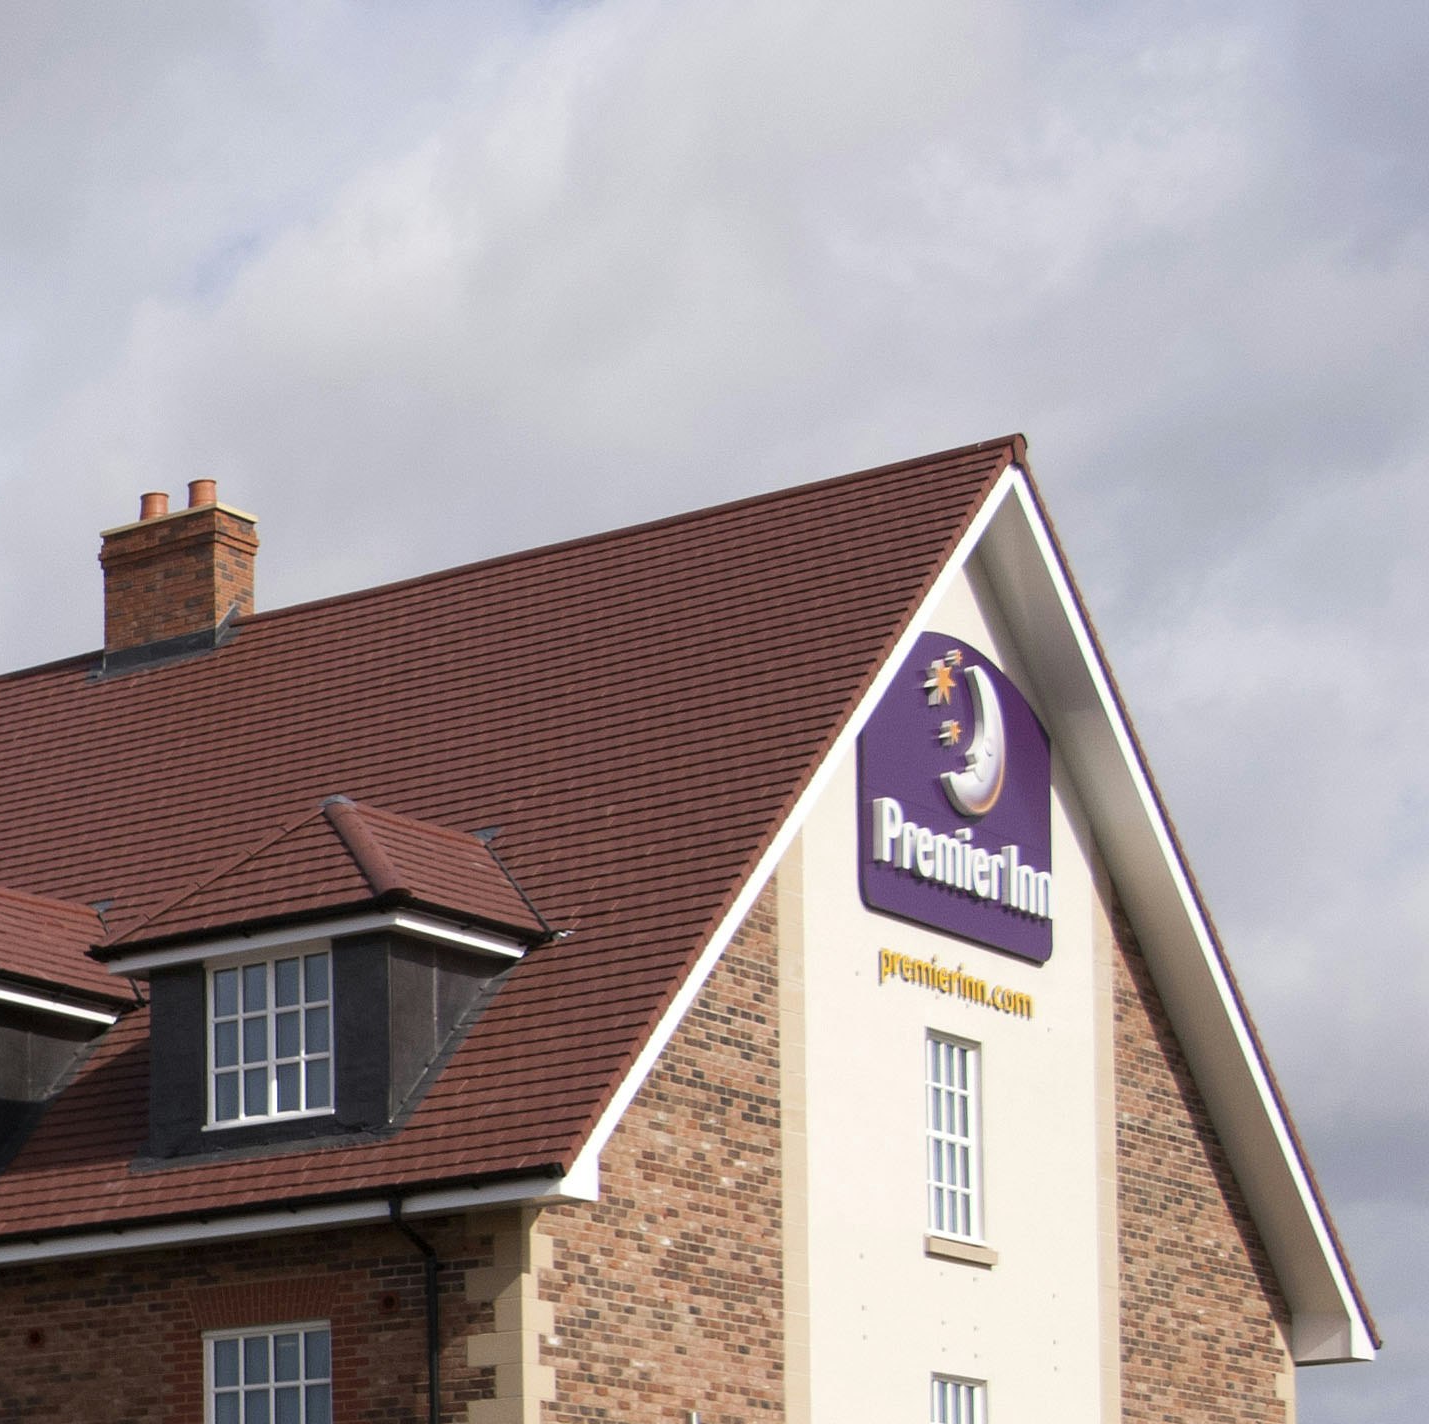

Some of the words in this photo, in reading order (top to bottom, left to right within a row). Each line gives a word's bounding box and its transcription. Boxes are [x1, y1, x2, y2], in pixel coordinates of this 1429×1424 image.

[873, 797, 1003, 900] Premier
[1002, 845, 1052, 919] Inn
[879, 948, 1033, 1020] premierinn.com
